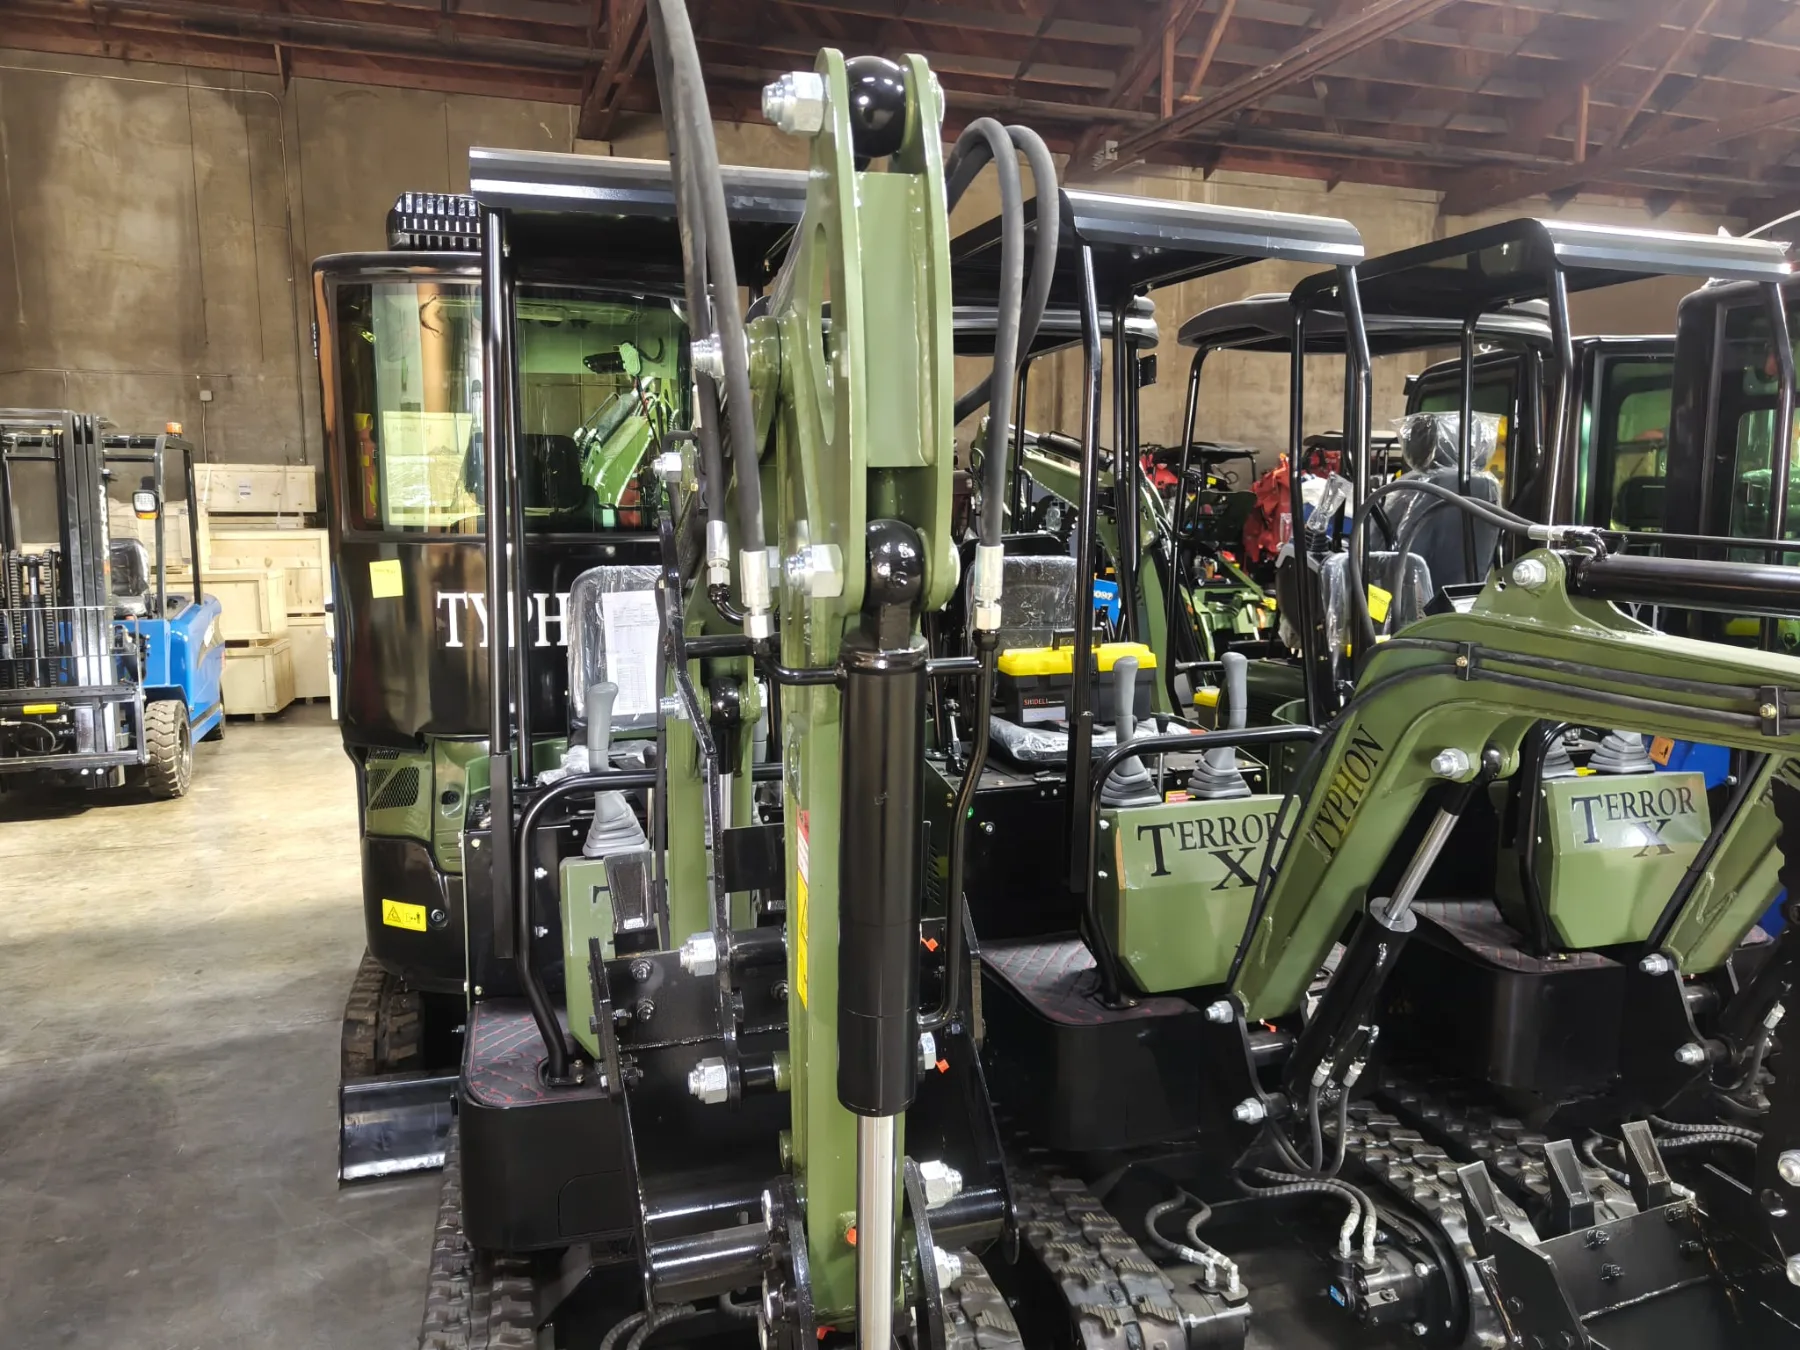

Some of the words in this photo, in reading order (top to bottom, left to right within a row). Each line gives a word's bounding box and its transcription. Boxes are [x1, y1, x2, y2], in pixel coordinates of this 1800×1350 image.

[1306, 724, 1384, 857] TYPHON
[1571, 787, 1697, 844] TERROR
[1137, 811, 1287, 877] TERROR
[1630, 819, 1675, 858] X
[1208, 846, 1259, 891] X
